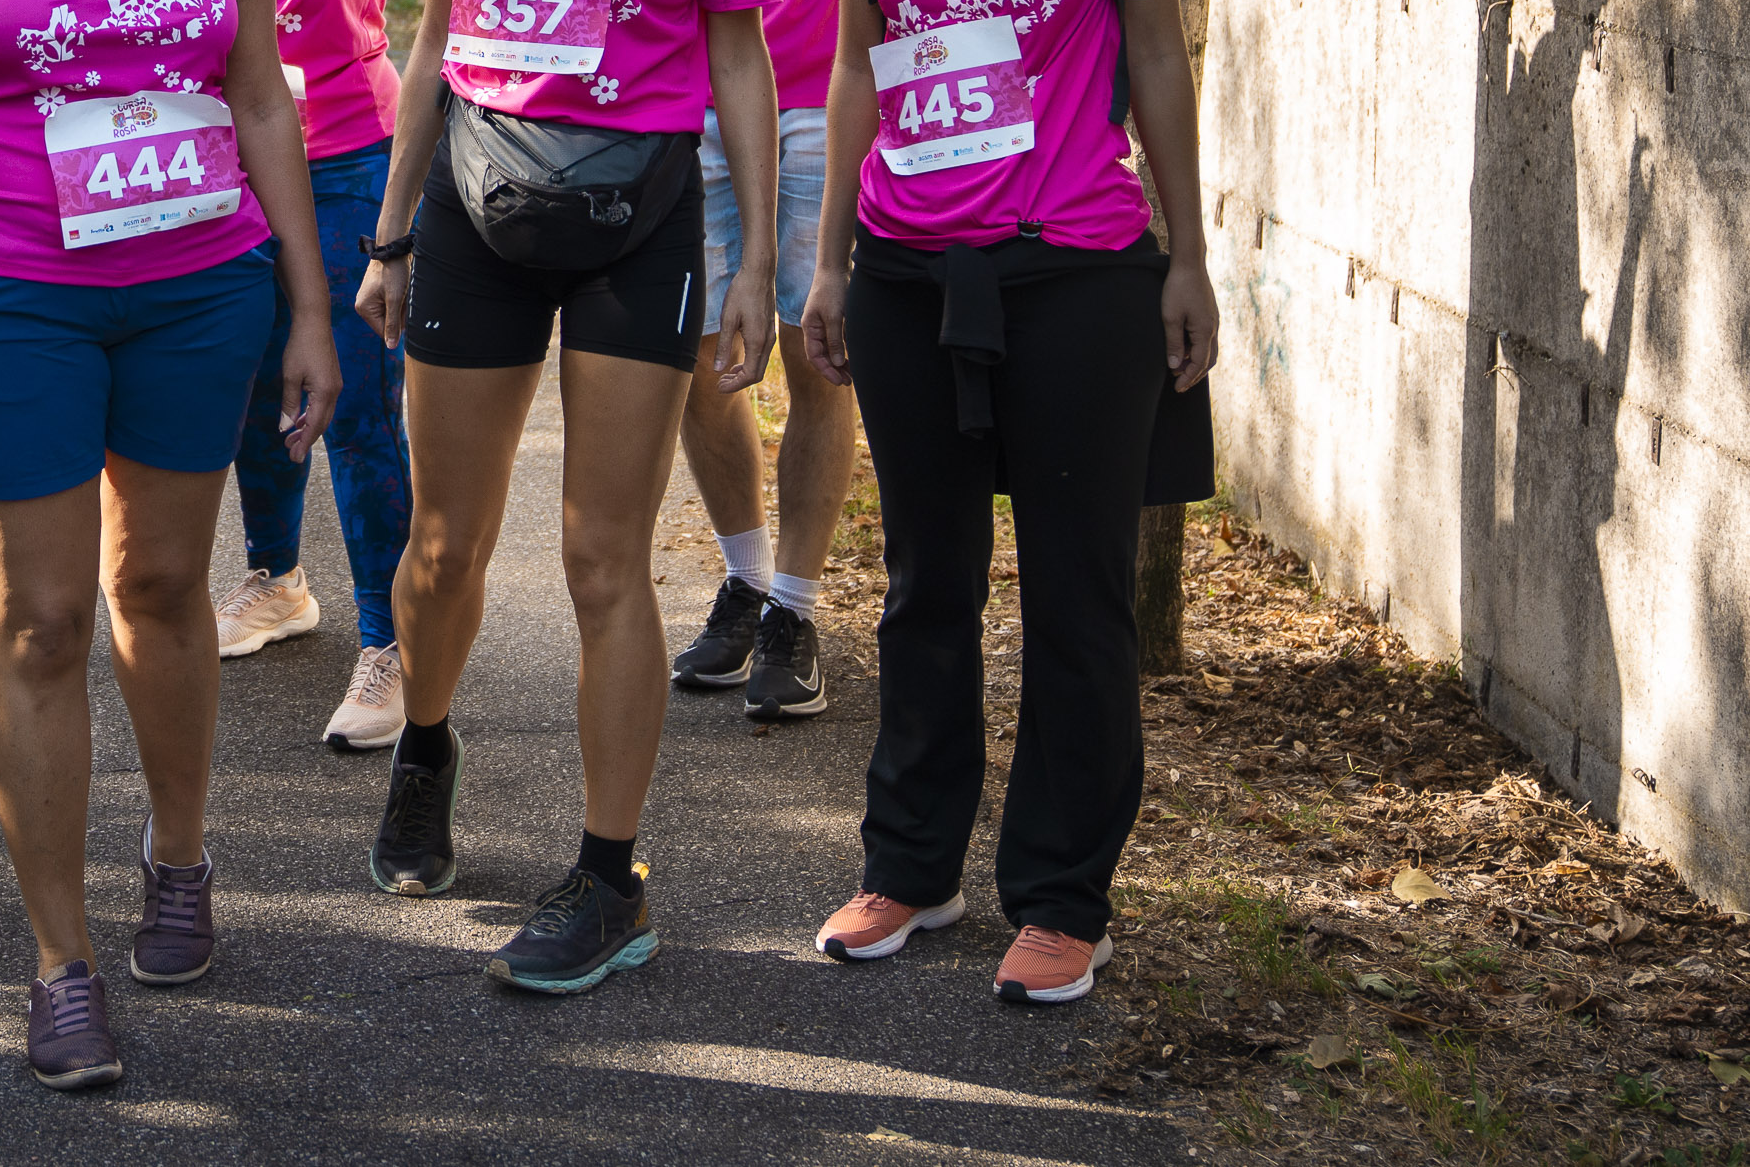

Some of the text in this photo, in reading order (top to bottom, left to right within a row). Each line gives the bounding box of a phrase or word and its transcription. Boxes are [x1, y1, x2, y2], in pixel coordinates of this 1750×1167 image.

[913, 62, 931, 76] ROSA
[117, 96, 147, 112] CORSA
[898, 75, 995, 135] 445
[113, 124, 137, 138] ROSA
[86, 139, 206, 200] 444
